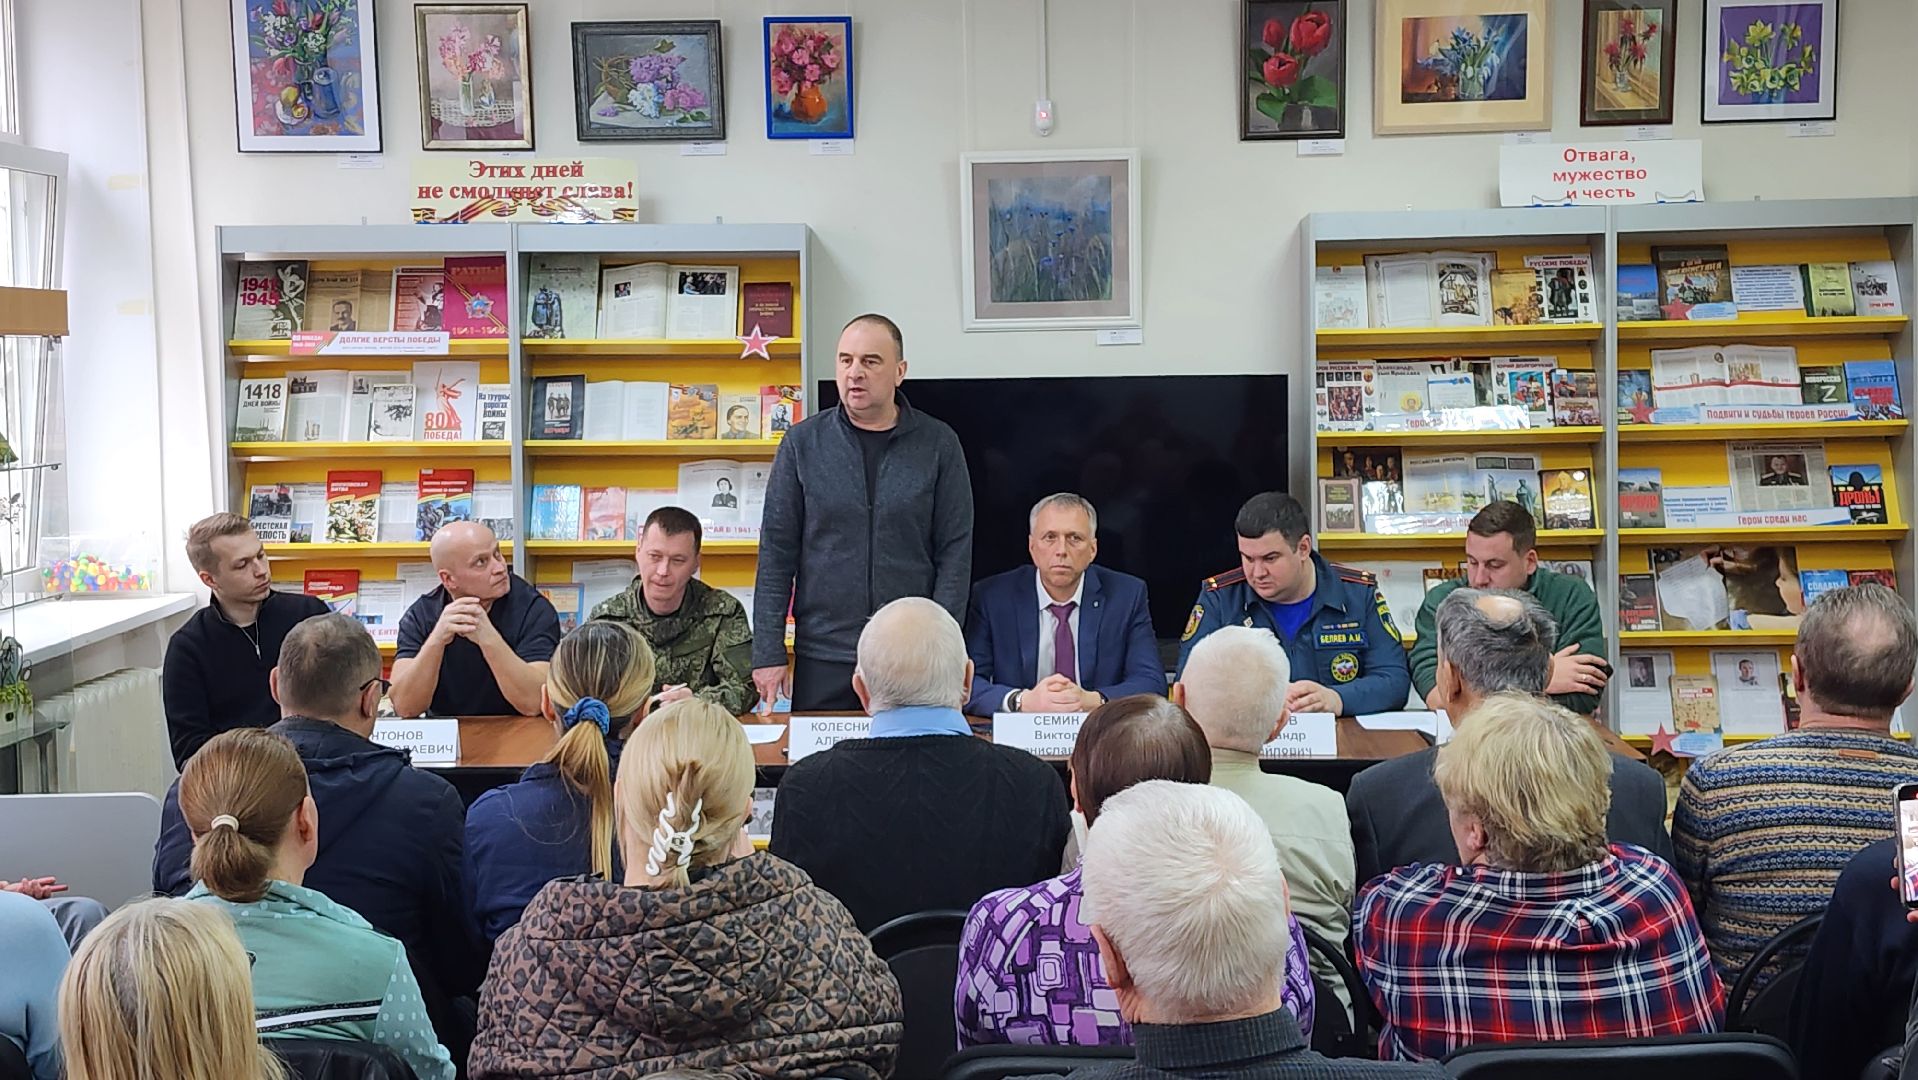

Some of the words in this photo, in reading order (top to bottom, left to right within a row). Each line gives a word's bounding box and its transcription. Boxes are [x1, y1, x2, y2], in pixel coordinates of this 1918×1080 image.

[1563, 148, 1636, 163] Отвага,
[469, 160, 525, 178] Этих
[530, 160, 584, 180] дней
[1553, 168, 1647, 184] мужество
[417, 186, 443, 199] не
[449, 186, 557, 200] смолкнет
[562, 181, 633, 199] слава!
[1566, 188, 1577, 199] и
[1582, 188, 1636, 199] честь
[240, 277, 278, 291] 1941
[239, 292, 279, 306] 1945
[338, 336, 370, 344] ДОЛГИЕ
[373, 336, 405, 344] ВЕРСТЫ
[407, 336, 441, 344] ПОБЕДЫ
[244, 383, 281, 400] 1418
[1821, 385, 1839, 403] Z
[243, 400, 259, 408] ДНЕЙ
[1706, 410, 1743, 419] Подвиги
[1744, 410, 1749, 418] и
[1752, 410, 1784, 420] судьбы
[1787, 410, 1816, 420] героев
[1817, 408, 1849, 418] России
[425, 412, 445, 430] 80
[424, 431, 462, 440] ПОБЕДА!
[1840, 489, 1881, 506] ДРОНЫ
[1737, 515, 1763, 526] Герои
[1764, 515, 1790, 524] среди
[1791, 514, 1808, 523] нас
[255, 530, 287, 540] РЕПОСТЬ
[1033, 715, 1080, 726] СЕМИН
[811, 722, 870, 732] КОЛЕСНИ
[371, 730, 424, 740] НТОНОВ
[1034, 730, 1078, 741] Виктор
